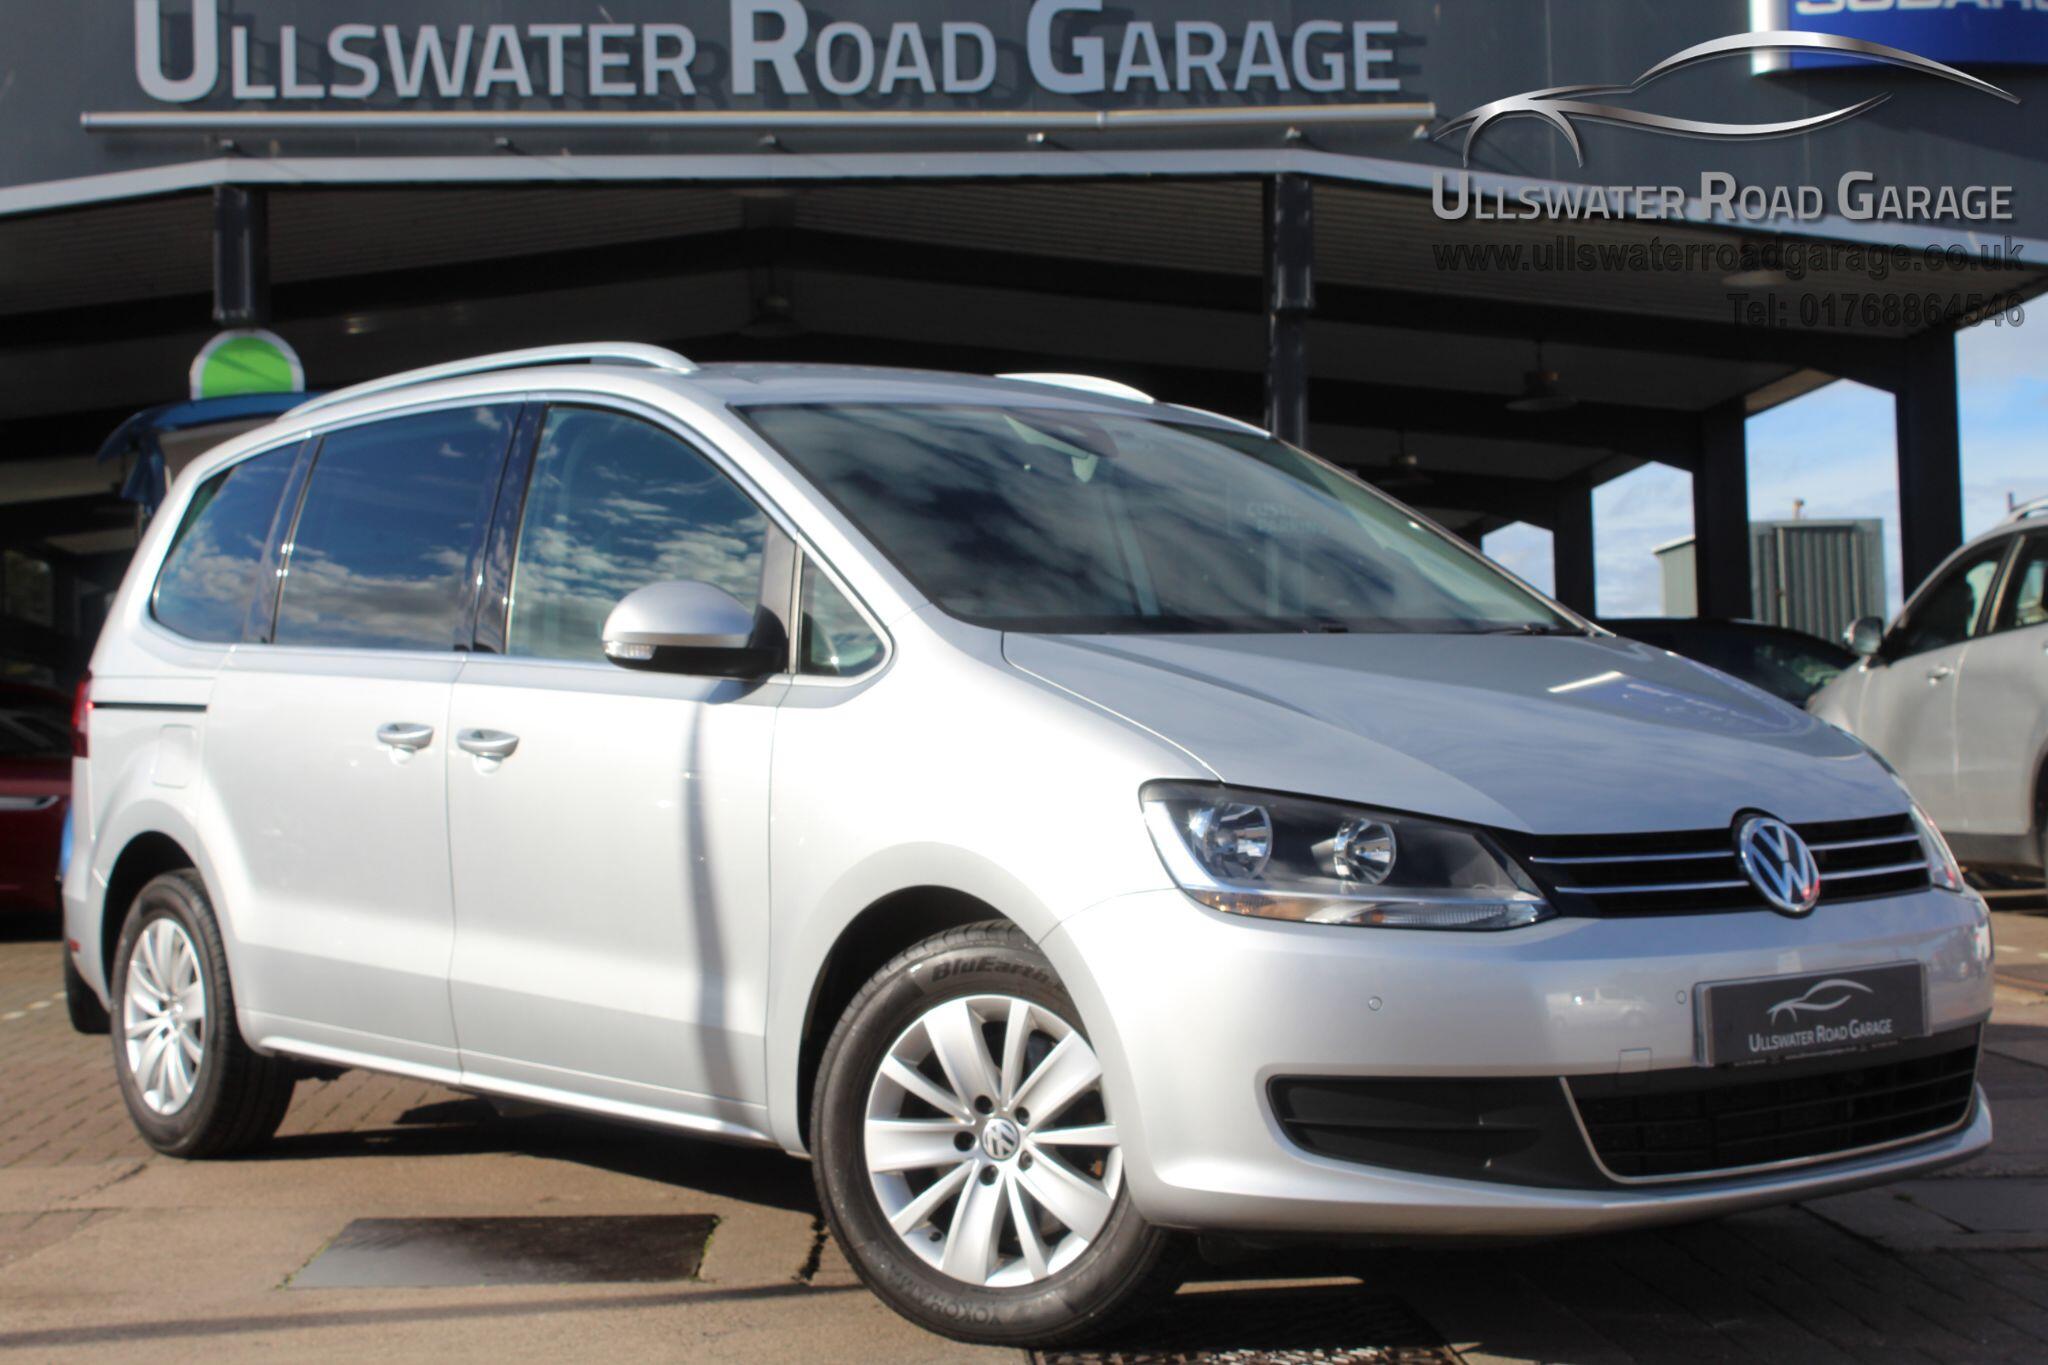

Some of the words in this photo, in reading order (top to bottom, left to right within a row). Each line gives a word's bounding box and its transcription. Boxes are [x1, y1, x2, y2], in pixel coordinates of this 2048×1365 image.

[135, 0, 697, 101] ULLSWATER
[730, 0, 997, 95] ROAD
[1026, 0, 1401, 94] GARAGE
[1748, 1032, 1815, 1053] ULLSWATER
[1815, 1025, 1849, 1043] ROAD
[1849, 1018, 1893, 1039] GARAGE
